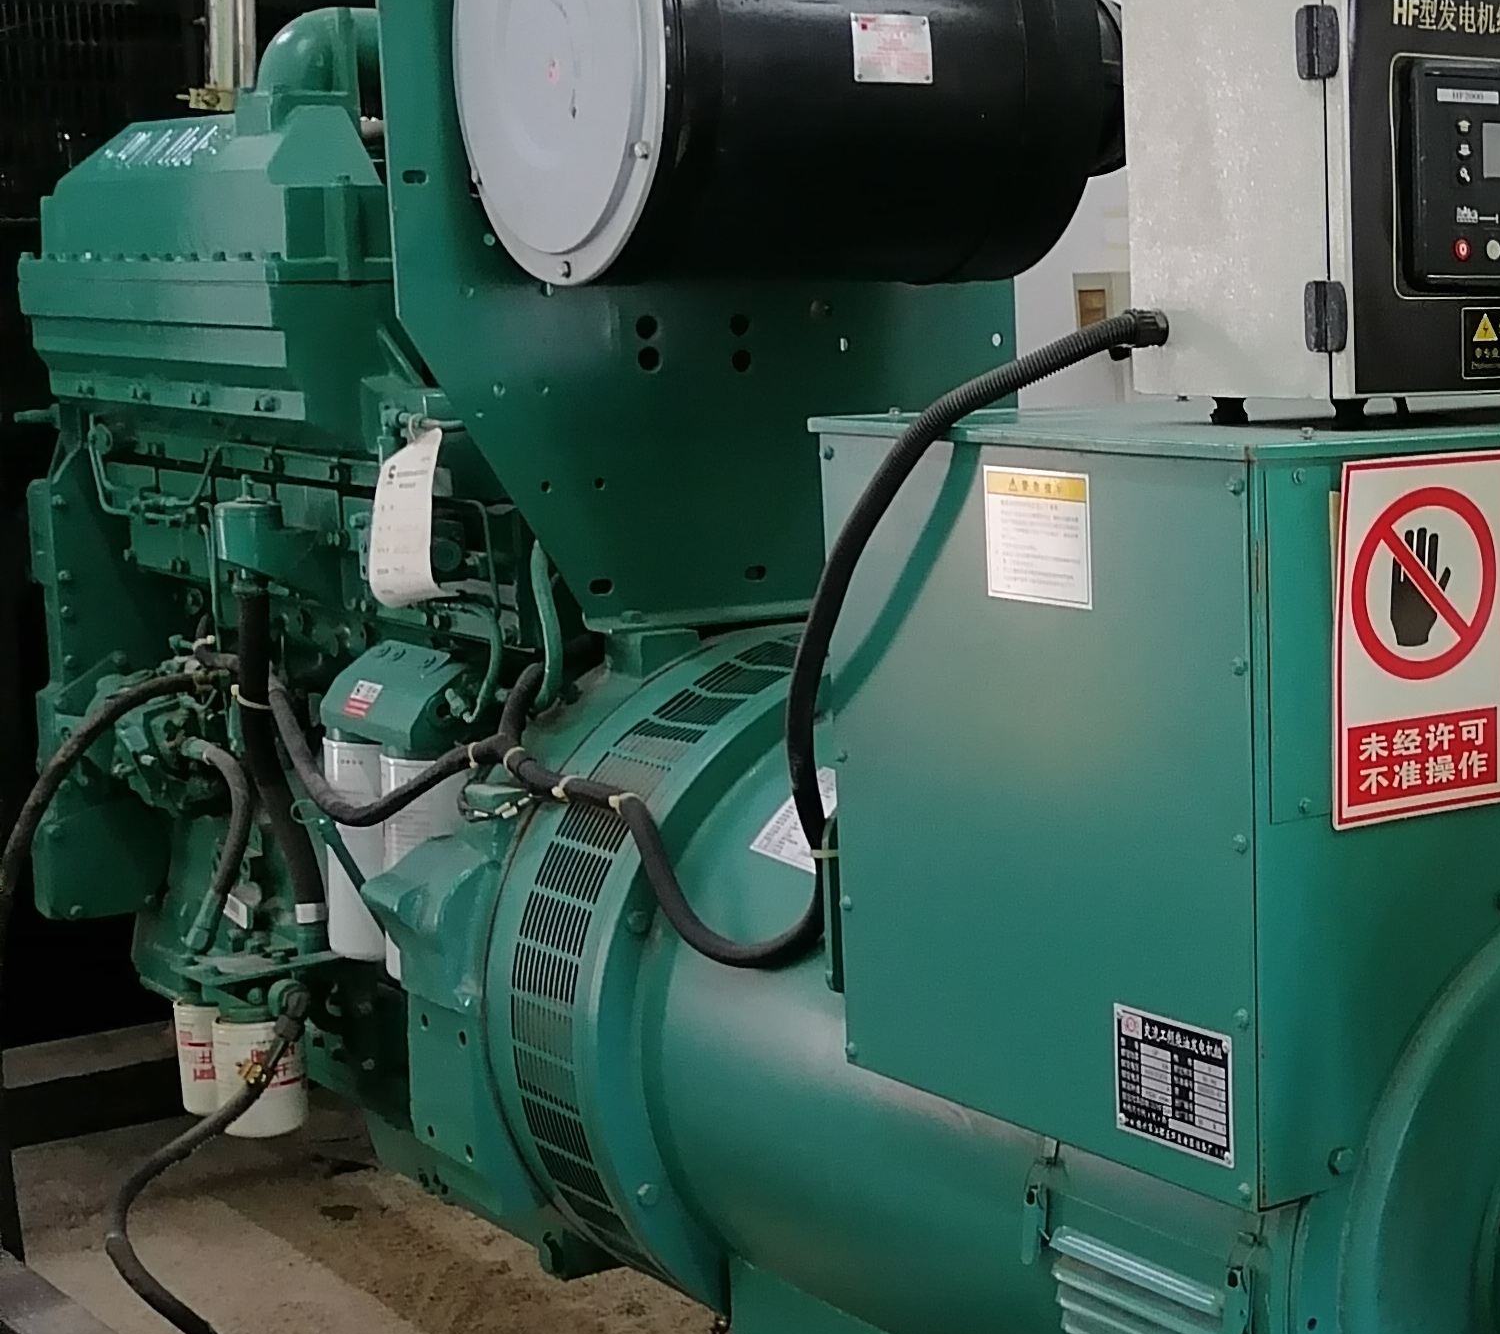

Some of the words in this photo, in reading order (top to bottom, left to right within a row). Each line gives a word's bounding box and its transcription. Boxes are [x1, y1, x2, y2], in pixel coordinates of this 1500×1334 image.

[1358, 718, 1488, 762] 未经许可
[1358, 750, 1489, 795] 不准操作
